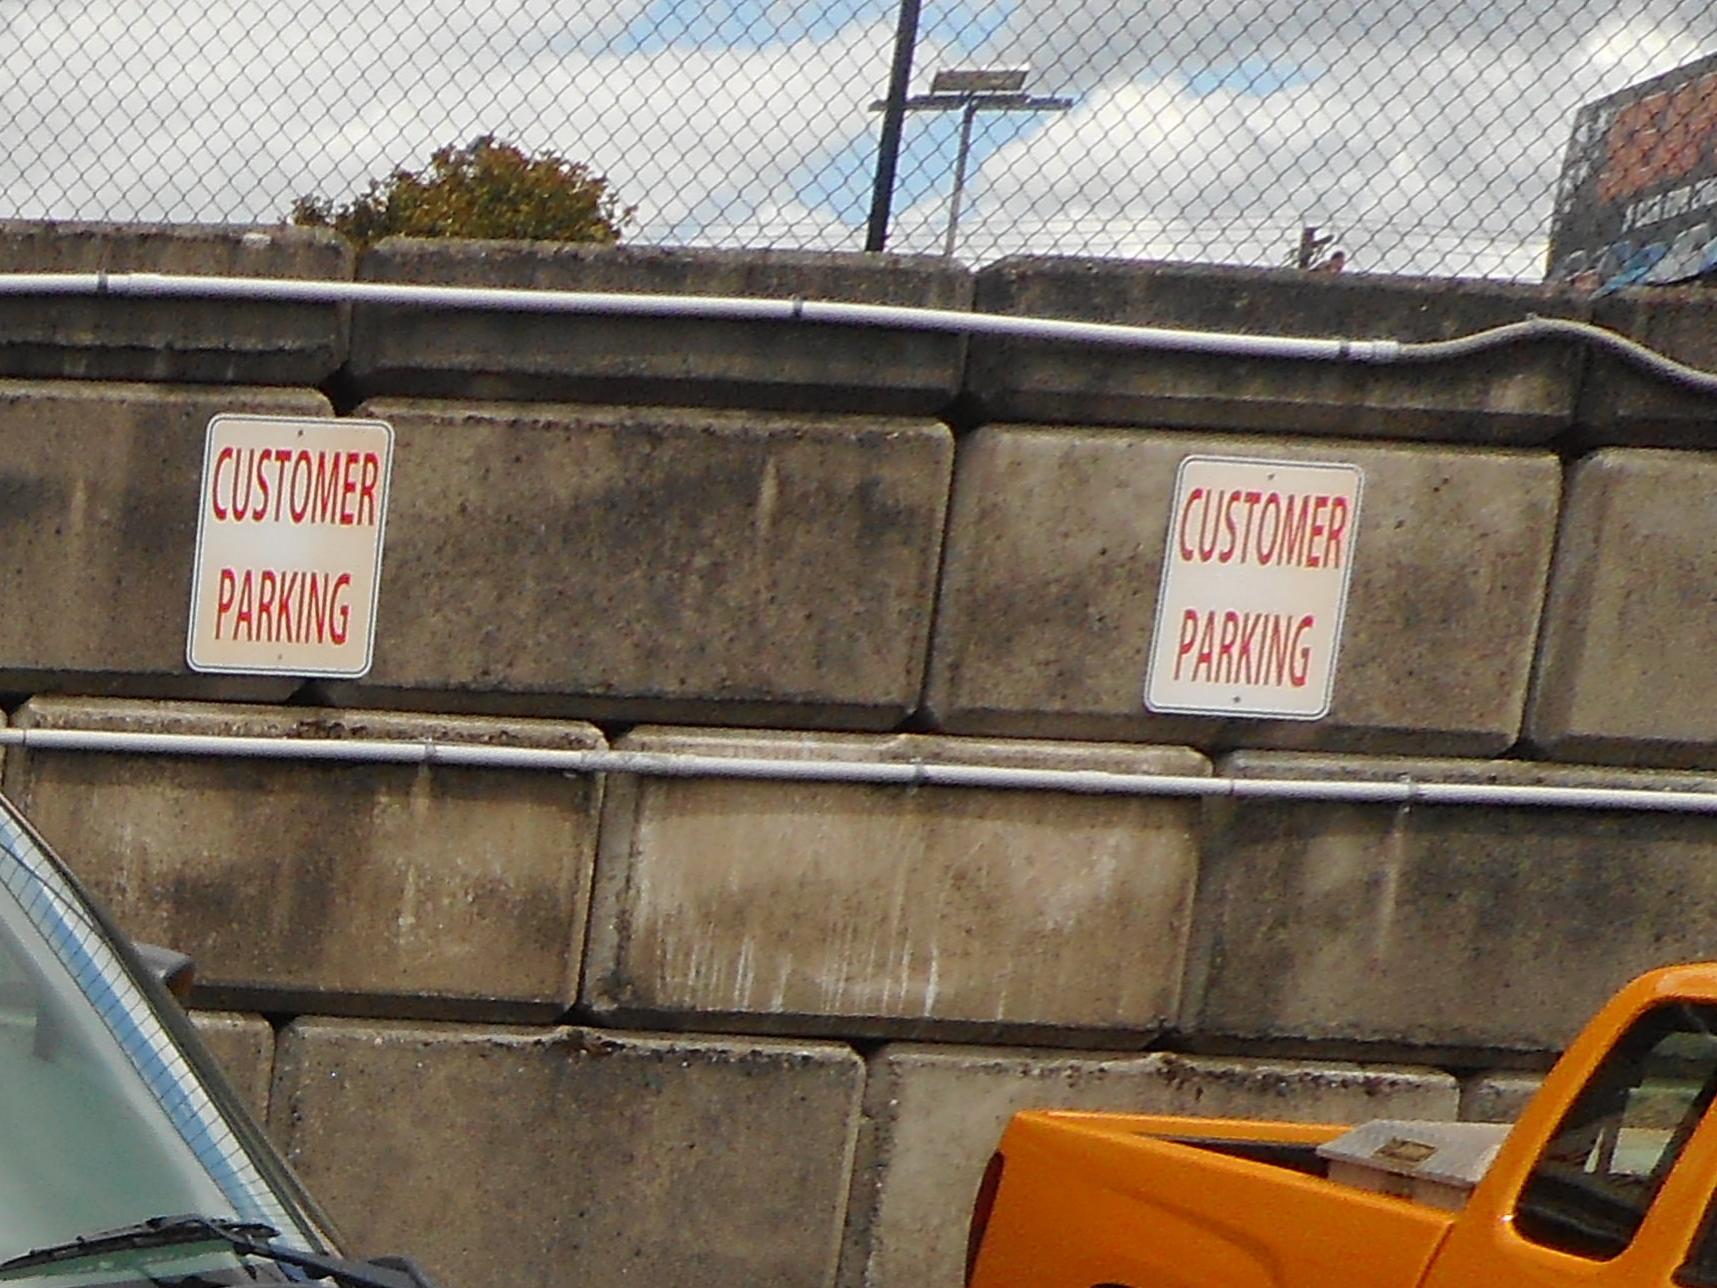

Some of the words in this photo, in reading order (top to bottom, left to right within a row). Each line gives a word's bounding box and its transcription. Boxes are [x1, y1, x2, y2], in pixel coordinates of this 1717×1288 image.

[212, 446, 381, 526] CUSTOMER
[1179, 487, 1349, 569] CUSTOMER
[214, 567, 353, 646] PARKING
[1173, 609, 1315, 688] PARKING
